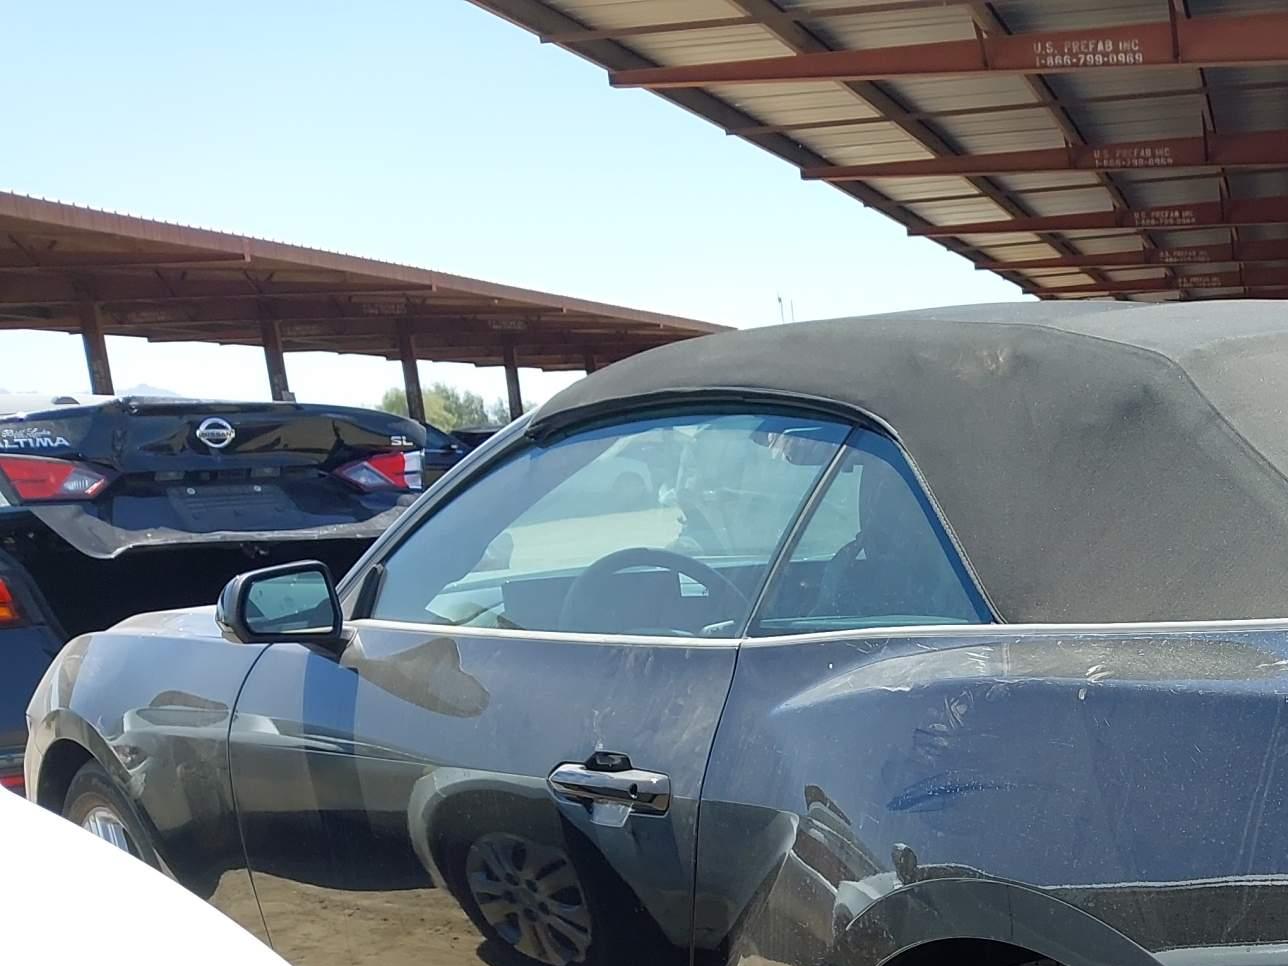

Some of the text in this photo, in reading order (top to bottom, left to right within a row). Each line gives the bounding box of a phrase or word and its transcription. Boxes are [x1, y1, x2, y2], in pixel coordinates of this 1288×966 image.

[1033, 41, 1058, 54] U.S.
[1064, 40, 1113, 53] PREFAB
[1035, 53, 1143, 67] 1-866-799-0969
[391, 435, 414, 446] SL
